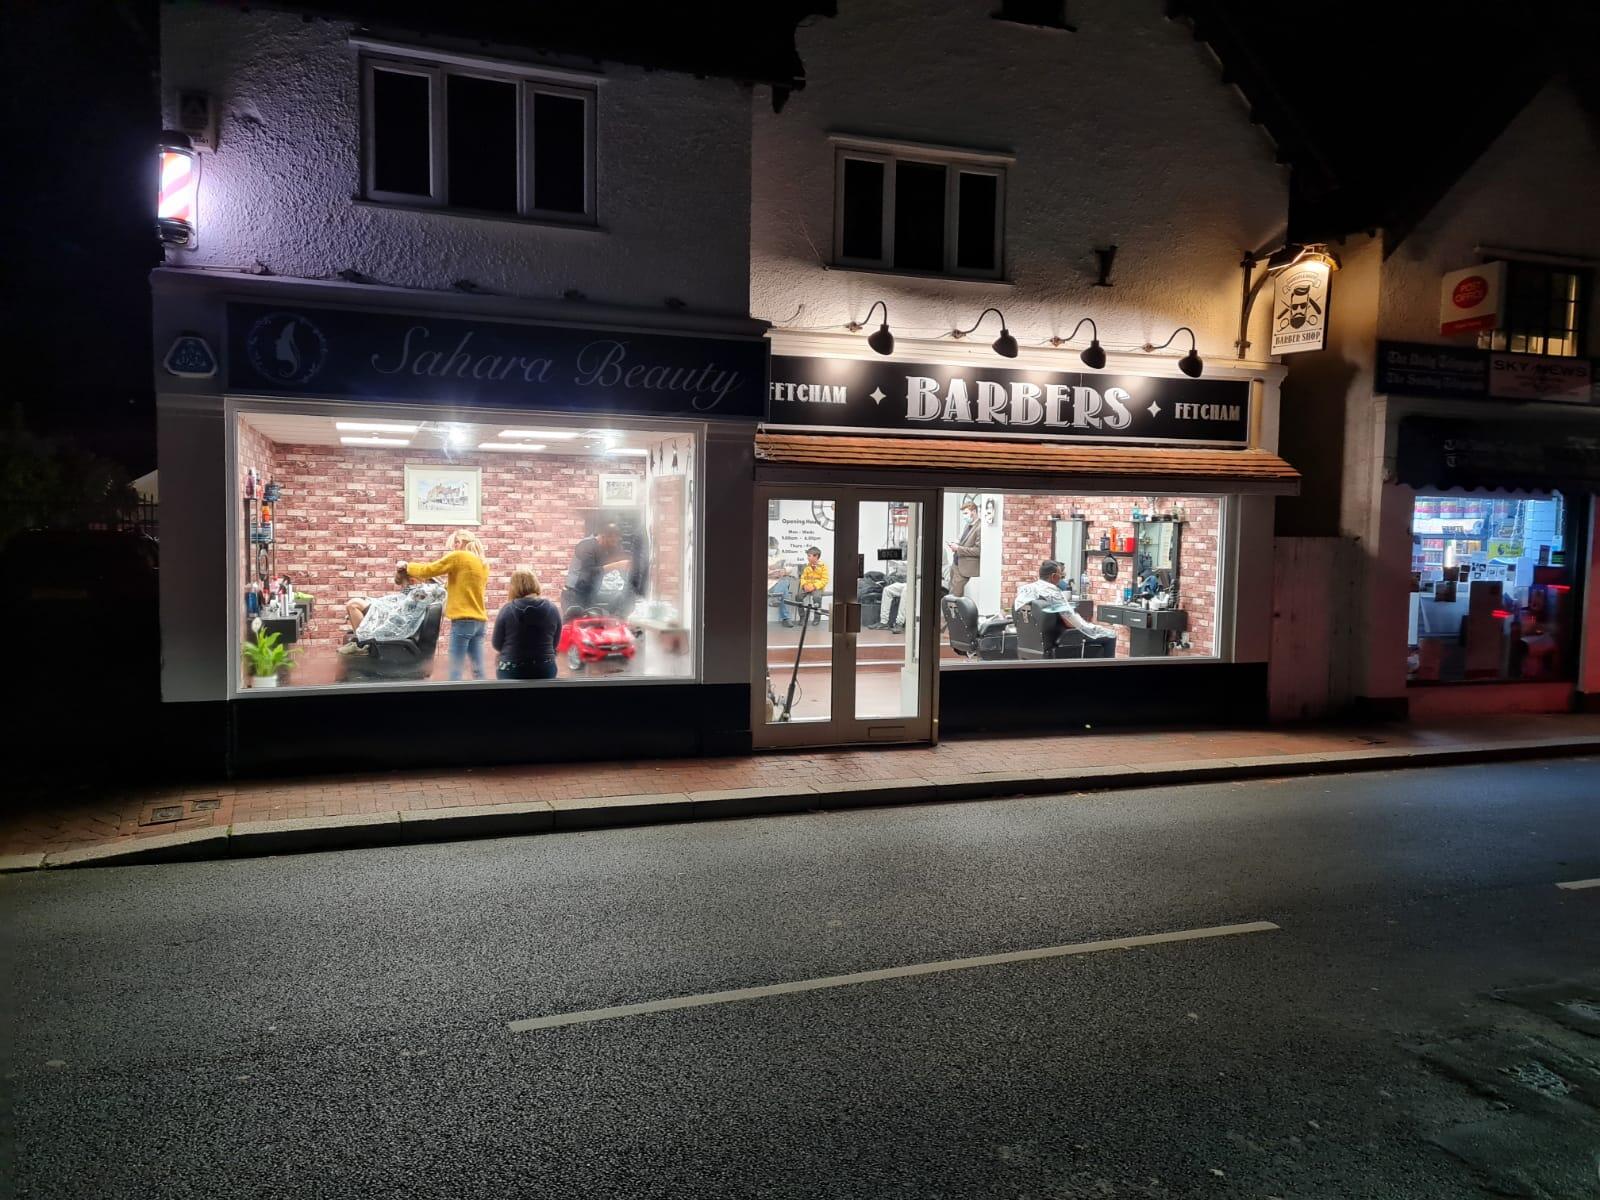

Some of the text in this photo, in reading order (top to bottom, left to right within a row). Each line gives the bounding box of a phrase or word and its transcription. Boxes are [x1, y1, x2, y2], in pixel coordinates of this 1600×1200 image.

[1275, 331, 1321, 345] BARBER SHOP
[371, 326, 744, 411] Sahara Beauty
[1493, 359, 1530, 372] SKY
[905, 376, 1132, 430] BARBERS
[1175, 402, 1241, 421] FETCHAM
[782, 518, 805, 526] Opening
